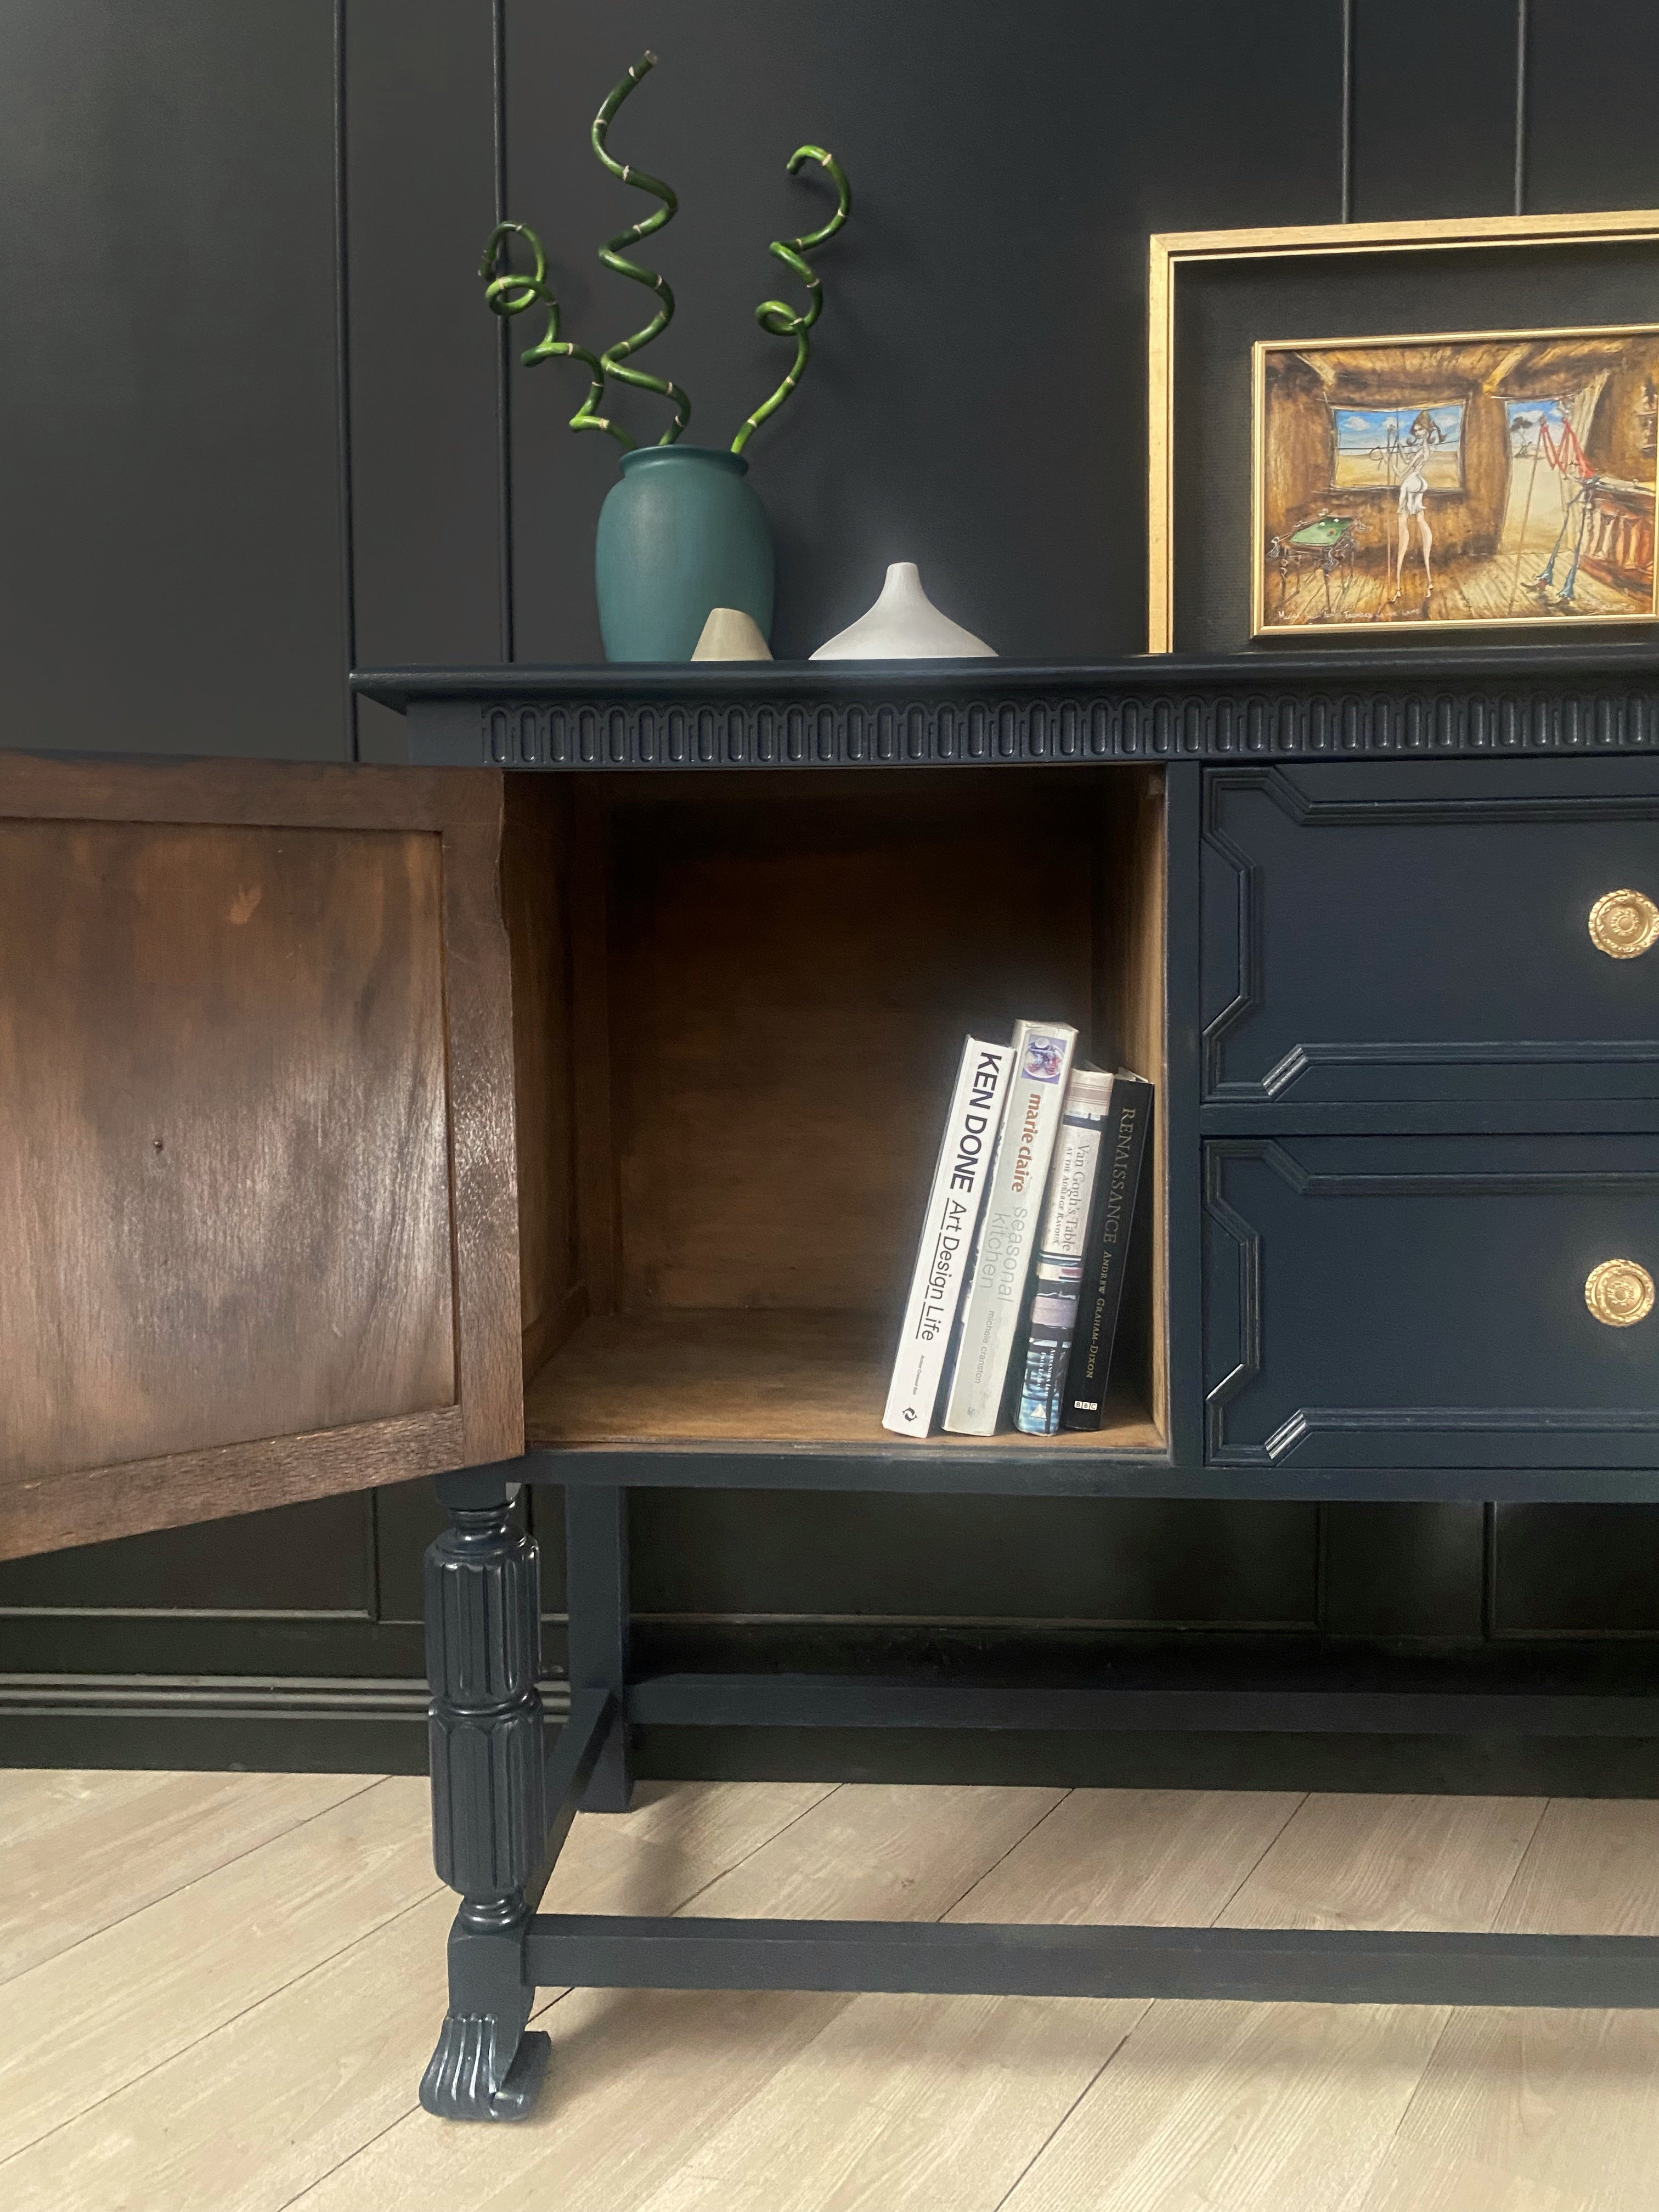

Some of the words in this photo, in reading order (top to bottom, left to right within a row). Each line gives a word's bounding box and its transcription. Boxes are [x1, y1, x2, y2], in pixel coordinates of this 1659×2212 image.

[969, 1052, 1002, 1110] KEN
[1022, 1093, 1041, 1143] marie
[950, 1114, 988, 1193] DONE
[1012, 1146, 1032, 1193] claire
[1075, 1144, 1090, 1167] Van
[1103, 1107, 1136, 1243] RENAISSANCE
[1058, 1175, 1069, 1210] AUBERGE
[945, 1200, 967, 1232] Art
[1062, 1218, 1079, 1251] Table
[929, 1236, 960, 1300] Design
[980, 1212, 1011, 1288] kitchen
[997, 1206, 1027, 1302] seasonal
[1098, 1251, 1112, 1295] ANDREW
[922, 1305, 944, 1341] Life
[983, 1310, 994, 1344] michele
[1086, 1298, 1105, 1379] GRAHAM-DIXON
[974, 1346, 987, 1384] cranston
[1075, 1401, 1097, 1410] BBC
